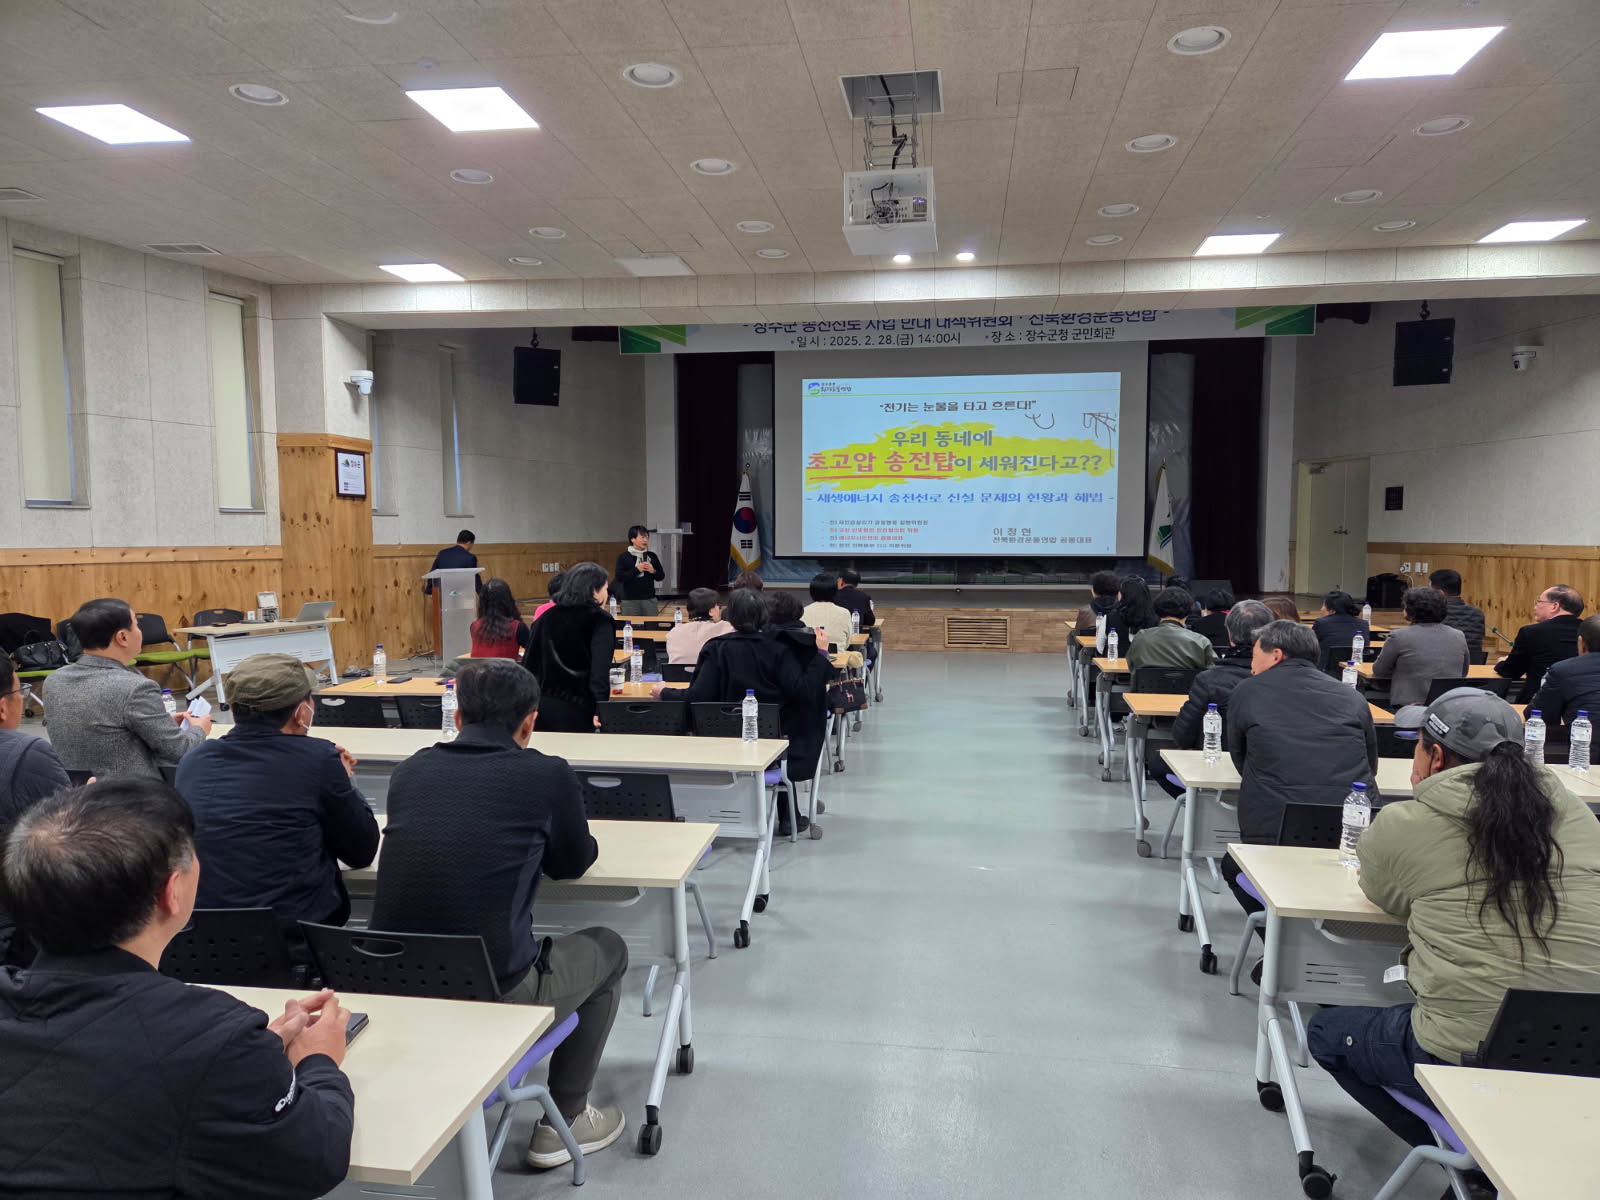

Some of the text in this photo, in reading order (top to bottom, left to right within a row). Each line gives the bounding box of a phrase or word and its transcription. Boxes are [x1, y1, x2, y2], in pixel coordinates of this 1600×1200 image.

[829, 335, 861, 347] 2025.
[865, 335, 875, 347] 2.
[918, 332, 961, 345] 14:00시
[1025, 329, 1069, 343] 장수군청
[1071, 327, 1115, 341] 군민회관
[923, 401, 958, 412] 눈물을
[963, 400, 988, 411] 타고
[891, 430, 993, 447] 우리 동네에
[806, 451, 1103, 473] 초고압 송전탑이 세워진다고??
[981, 492, 1021, 503] 문제의
[1074, 492, 1104, 503] 해법
